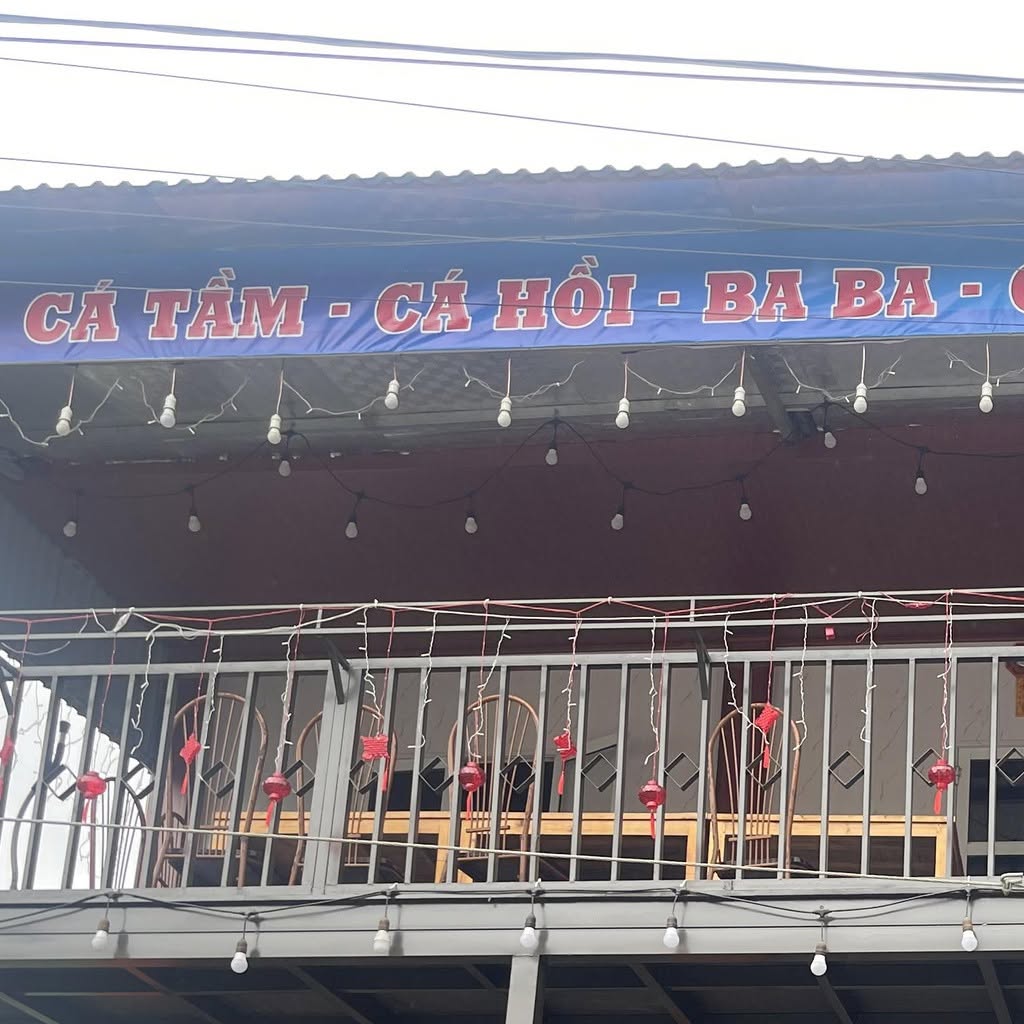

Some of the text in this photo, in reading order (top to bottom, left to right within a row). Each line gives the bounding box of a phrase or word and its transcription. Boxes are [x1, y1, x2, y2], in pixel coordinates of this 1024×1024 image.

[24, 279, 120, 344] CÁ
[145, 267, 309, 341] TẦM
[374, 269, 472, 335] CÁ
[494, 255, 638, 331] HỒI
[703, 269, 808, 324] BA
[831, 265, 937, 320] BA
